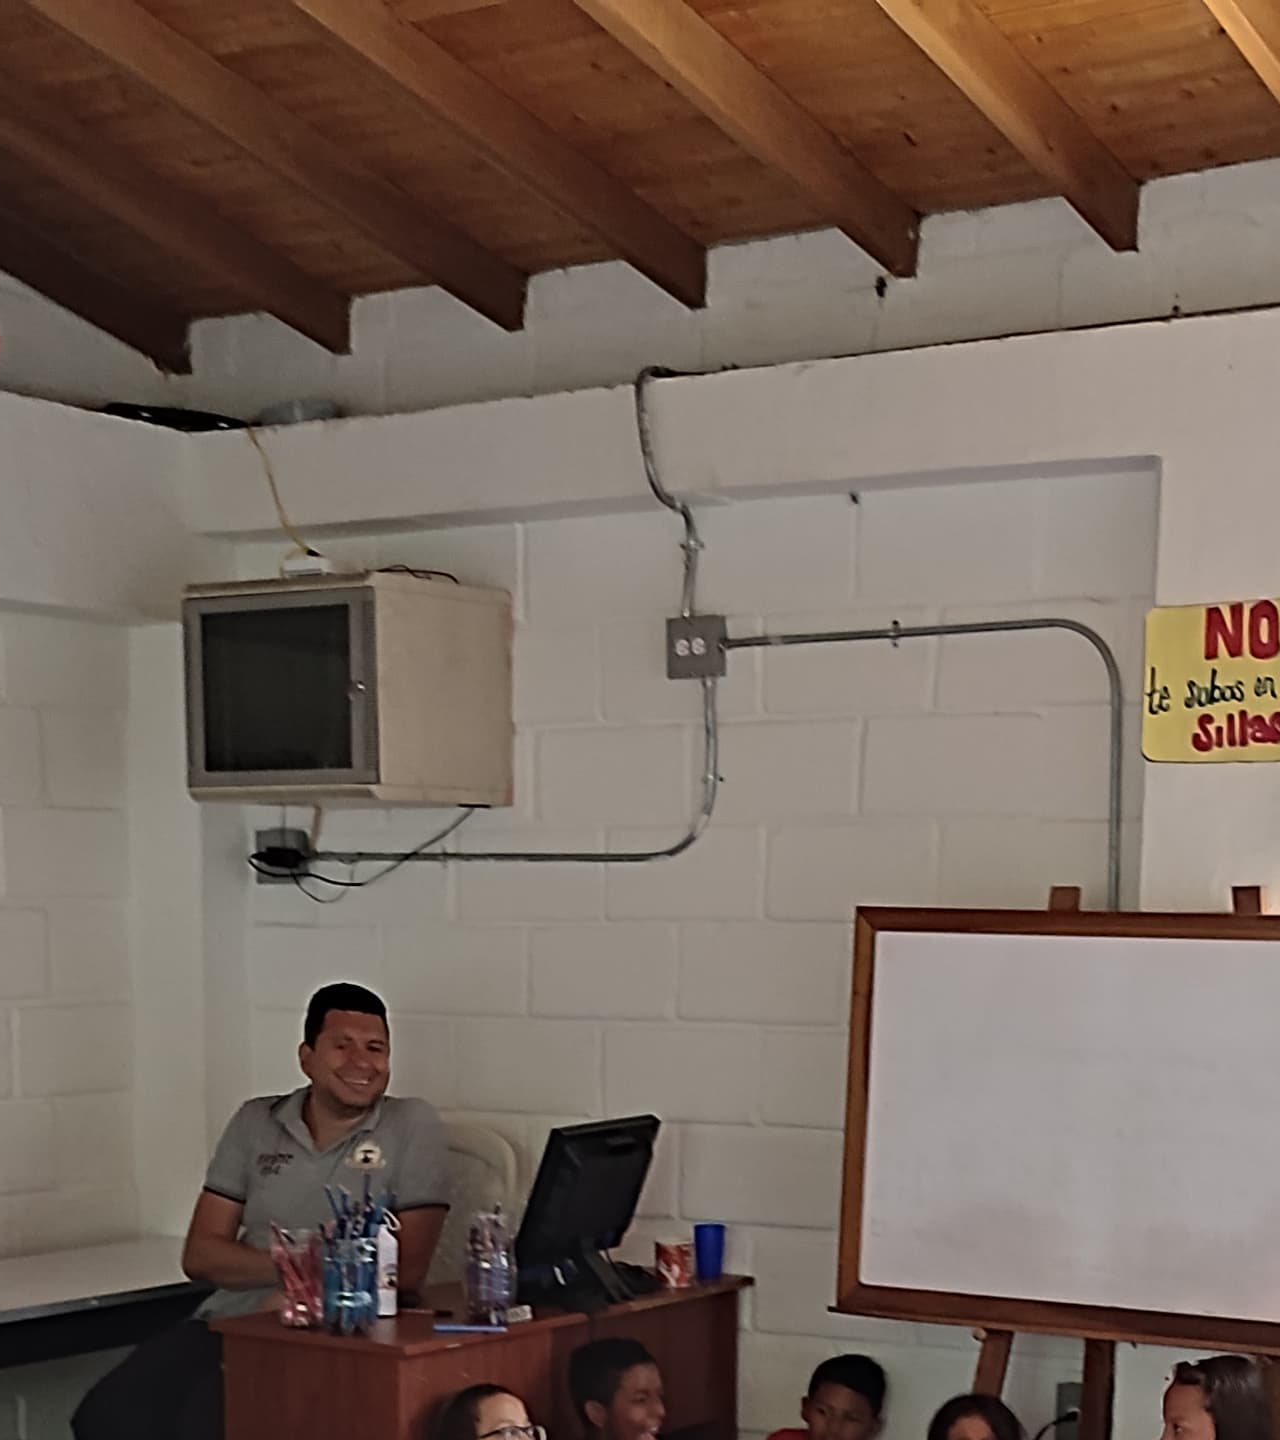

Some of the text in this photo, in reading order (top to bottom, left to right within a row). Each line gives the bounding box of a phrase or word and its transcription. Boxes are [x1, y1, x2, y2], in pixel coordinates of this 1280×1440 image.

[1204, 600, 1280, 660] NO
[1145, 667, 1170, 714] te
[1254, 677, 1277, 699] en
